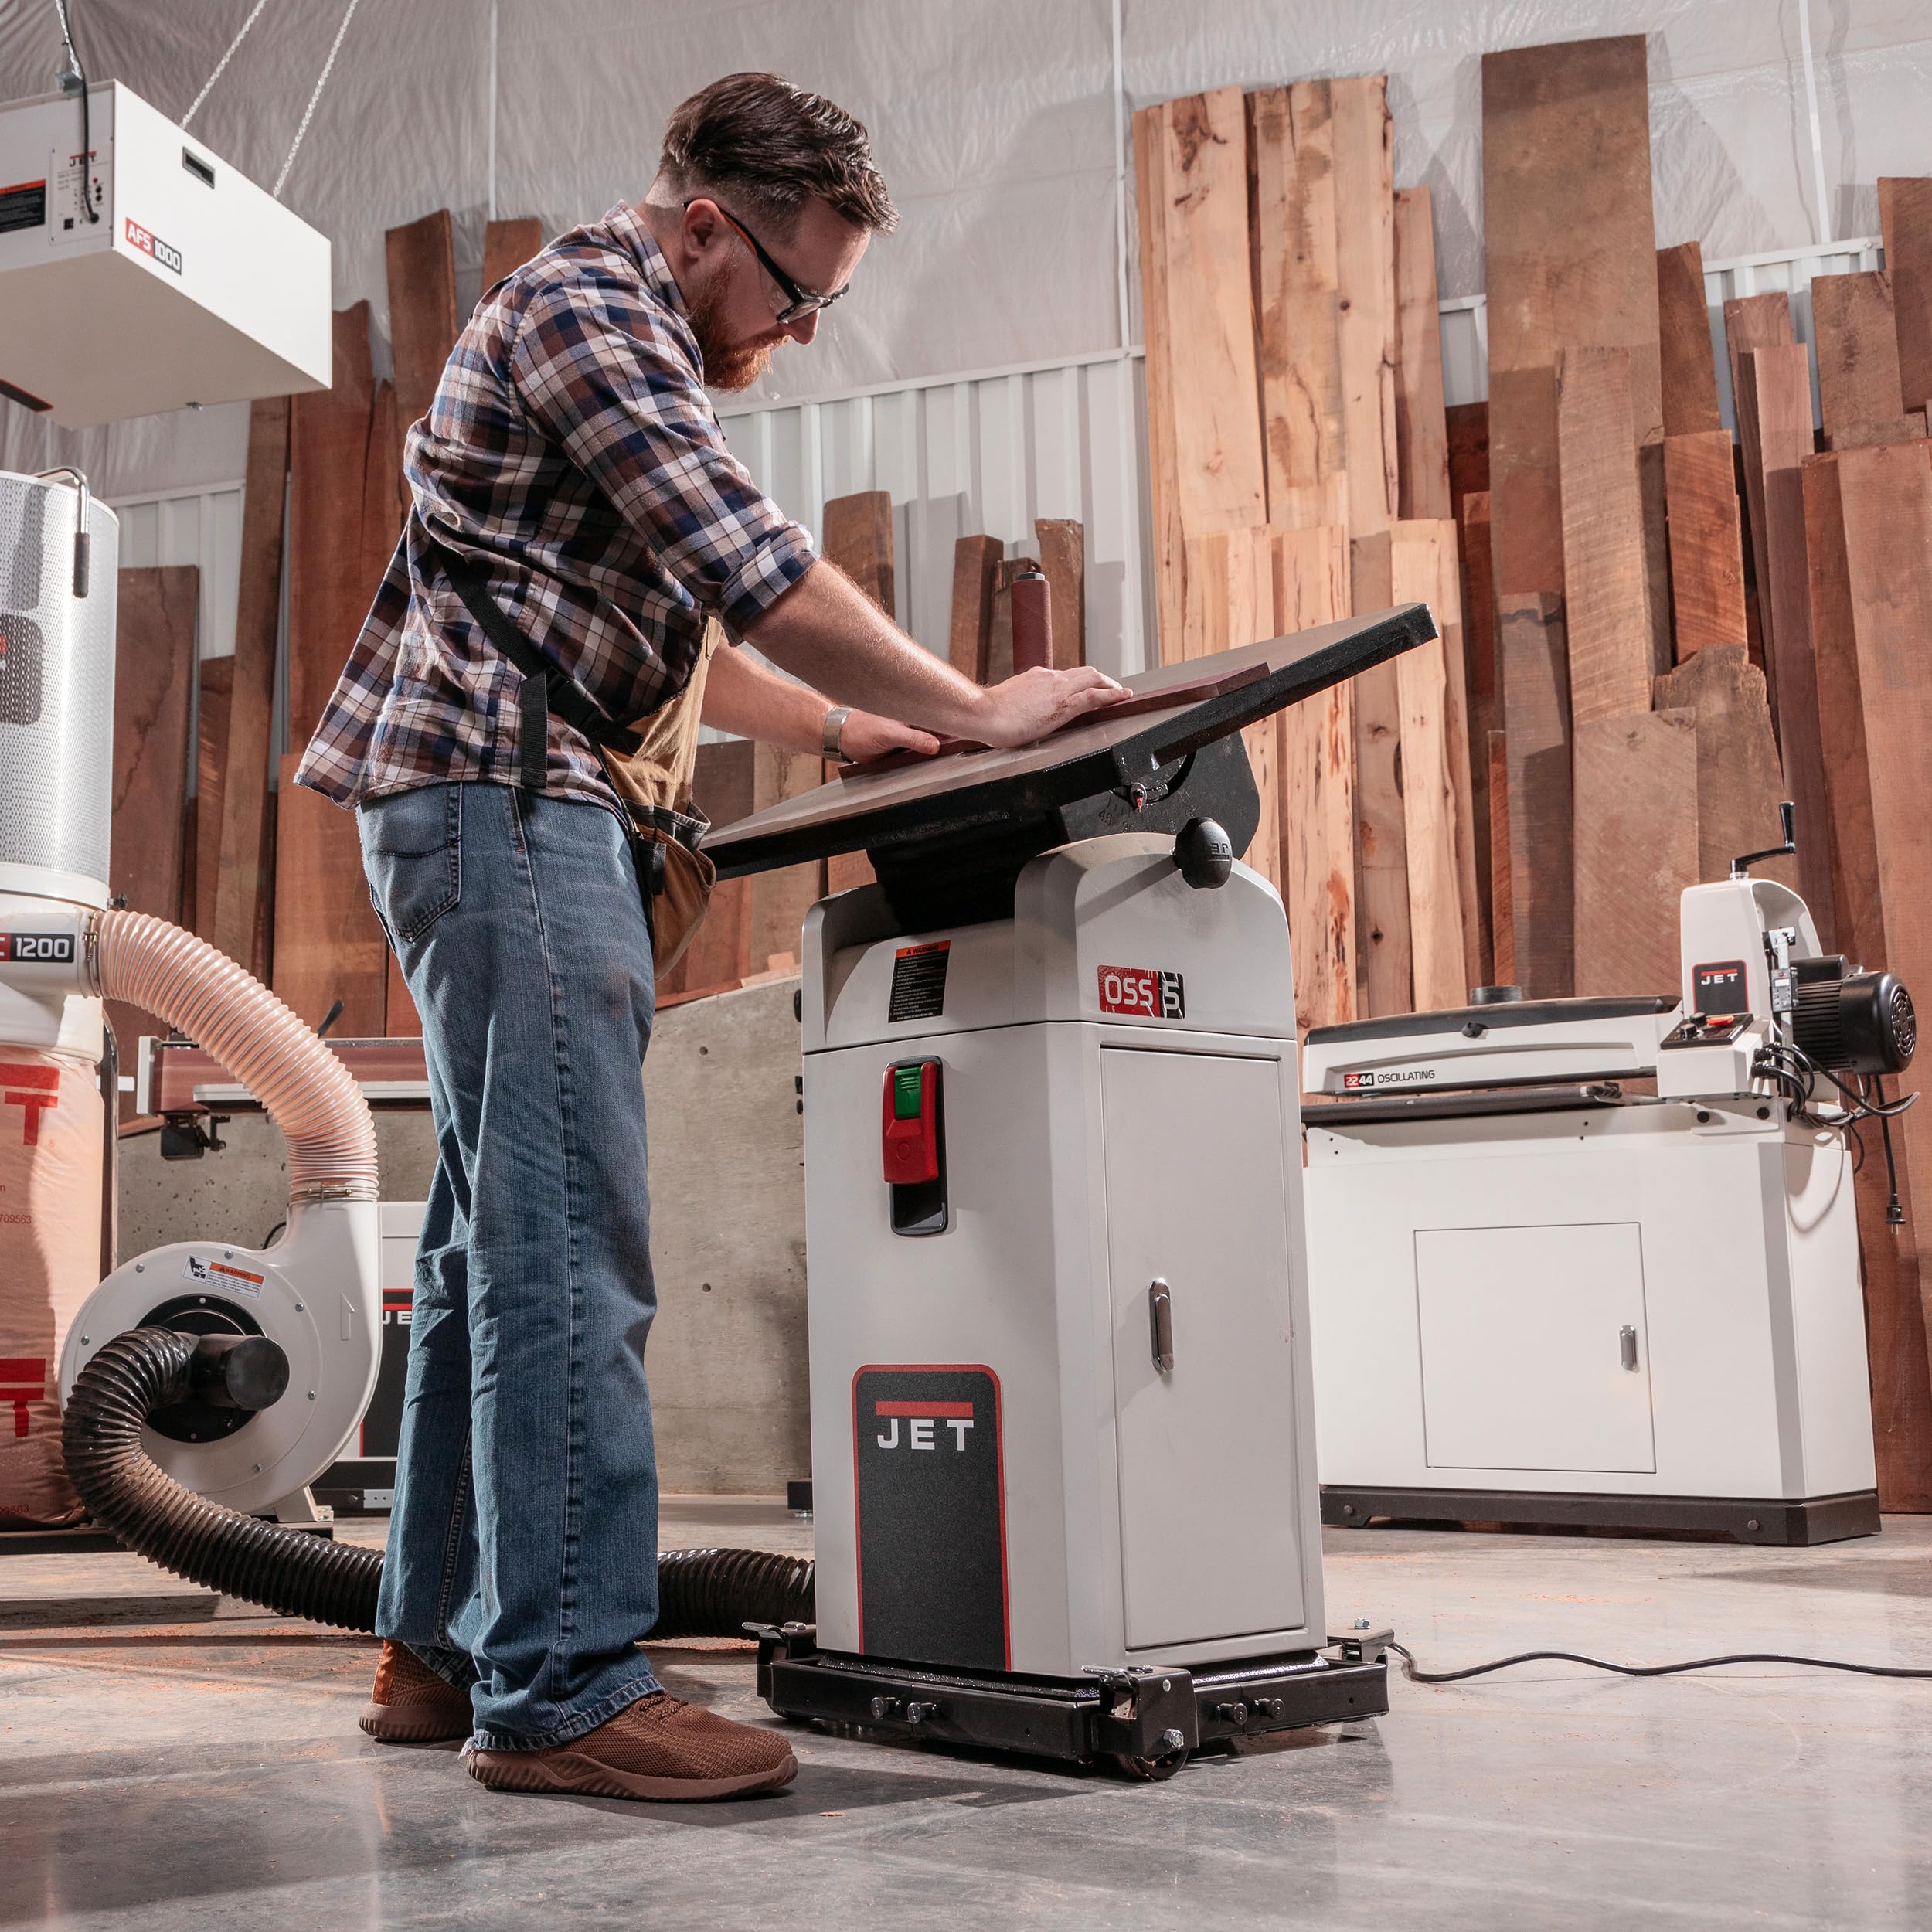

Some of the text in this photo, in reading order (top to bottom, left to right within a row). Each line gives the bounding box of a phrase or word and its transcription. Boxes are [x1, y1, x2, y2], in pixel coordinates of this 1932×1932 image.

[128, 223, 181, 271] AFS 1000
[16, 937, 70, 958] 1200
[913, 944, 939, 954] WARNING
[1701, 973, 1738, 985] JET
[1105, 975, 1179, 1010] OSS 5
[1345, 1070, 1435, 1087] 2244 OSCILLATING
[226, 1267, 251, 1280] WARNING
[383, 1311, 412, 1325] JE
[877, 1418, 974, 1451] JET
